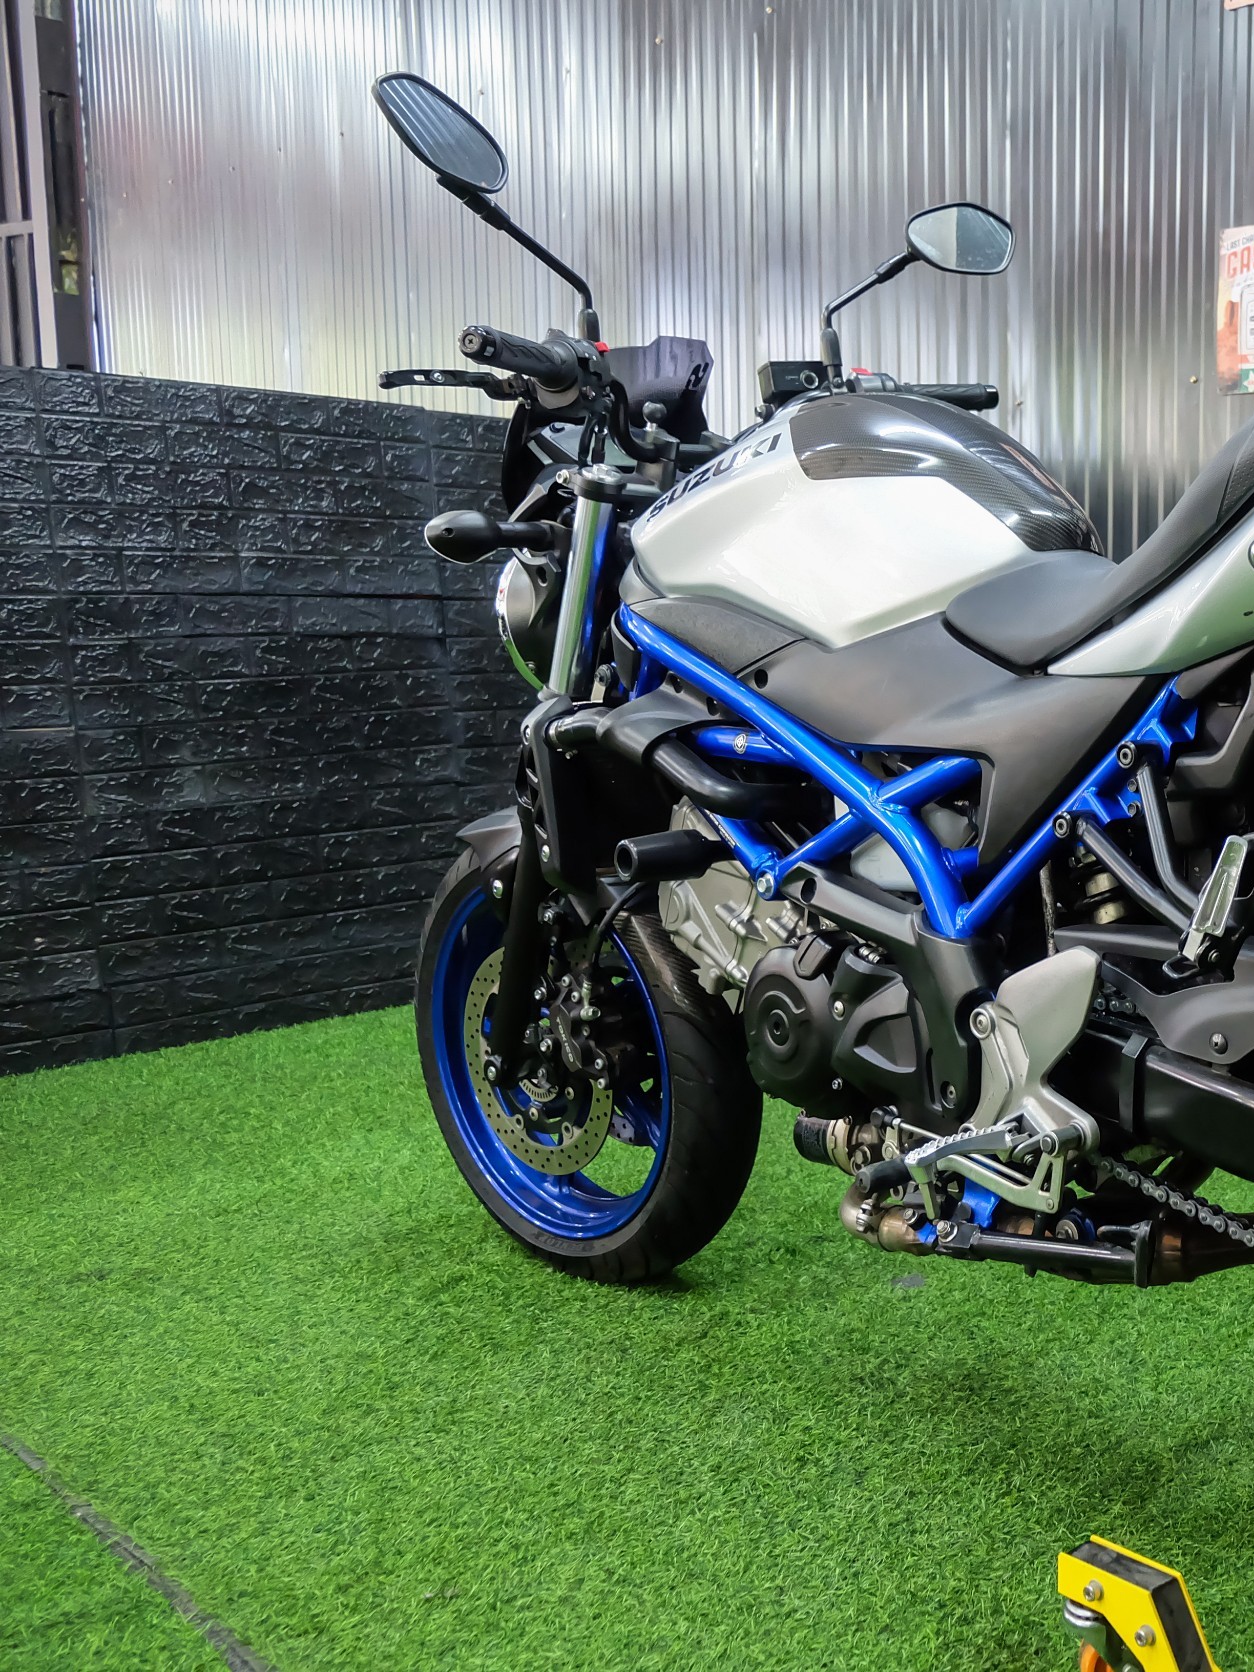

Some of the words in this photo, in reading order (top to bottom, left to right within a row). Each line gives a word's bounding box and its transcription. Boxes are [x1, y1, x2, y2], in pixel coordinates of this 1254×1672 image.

[1226, 240, 1240, 252] LAST
[646, 432, 783, 523] SUZUKI
[556, 1016, 574, 1063] TOKICO
